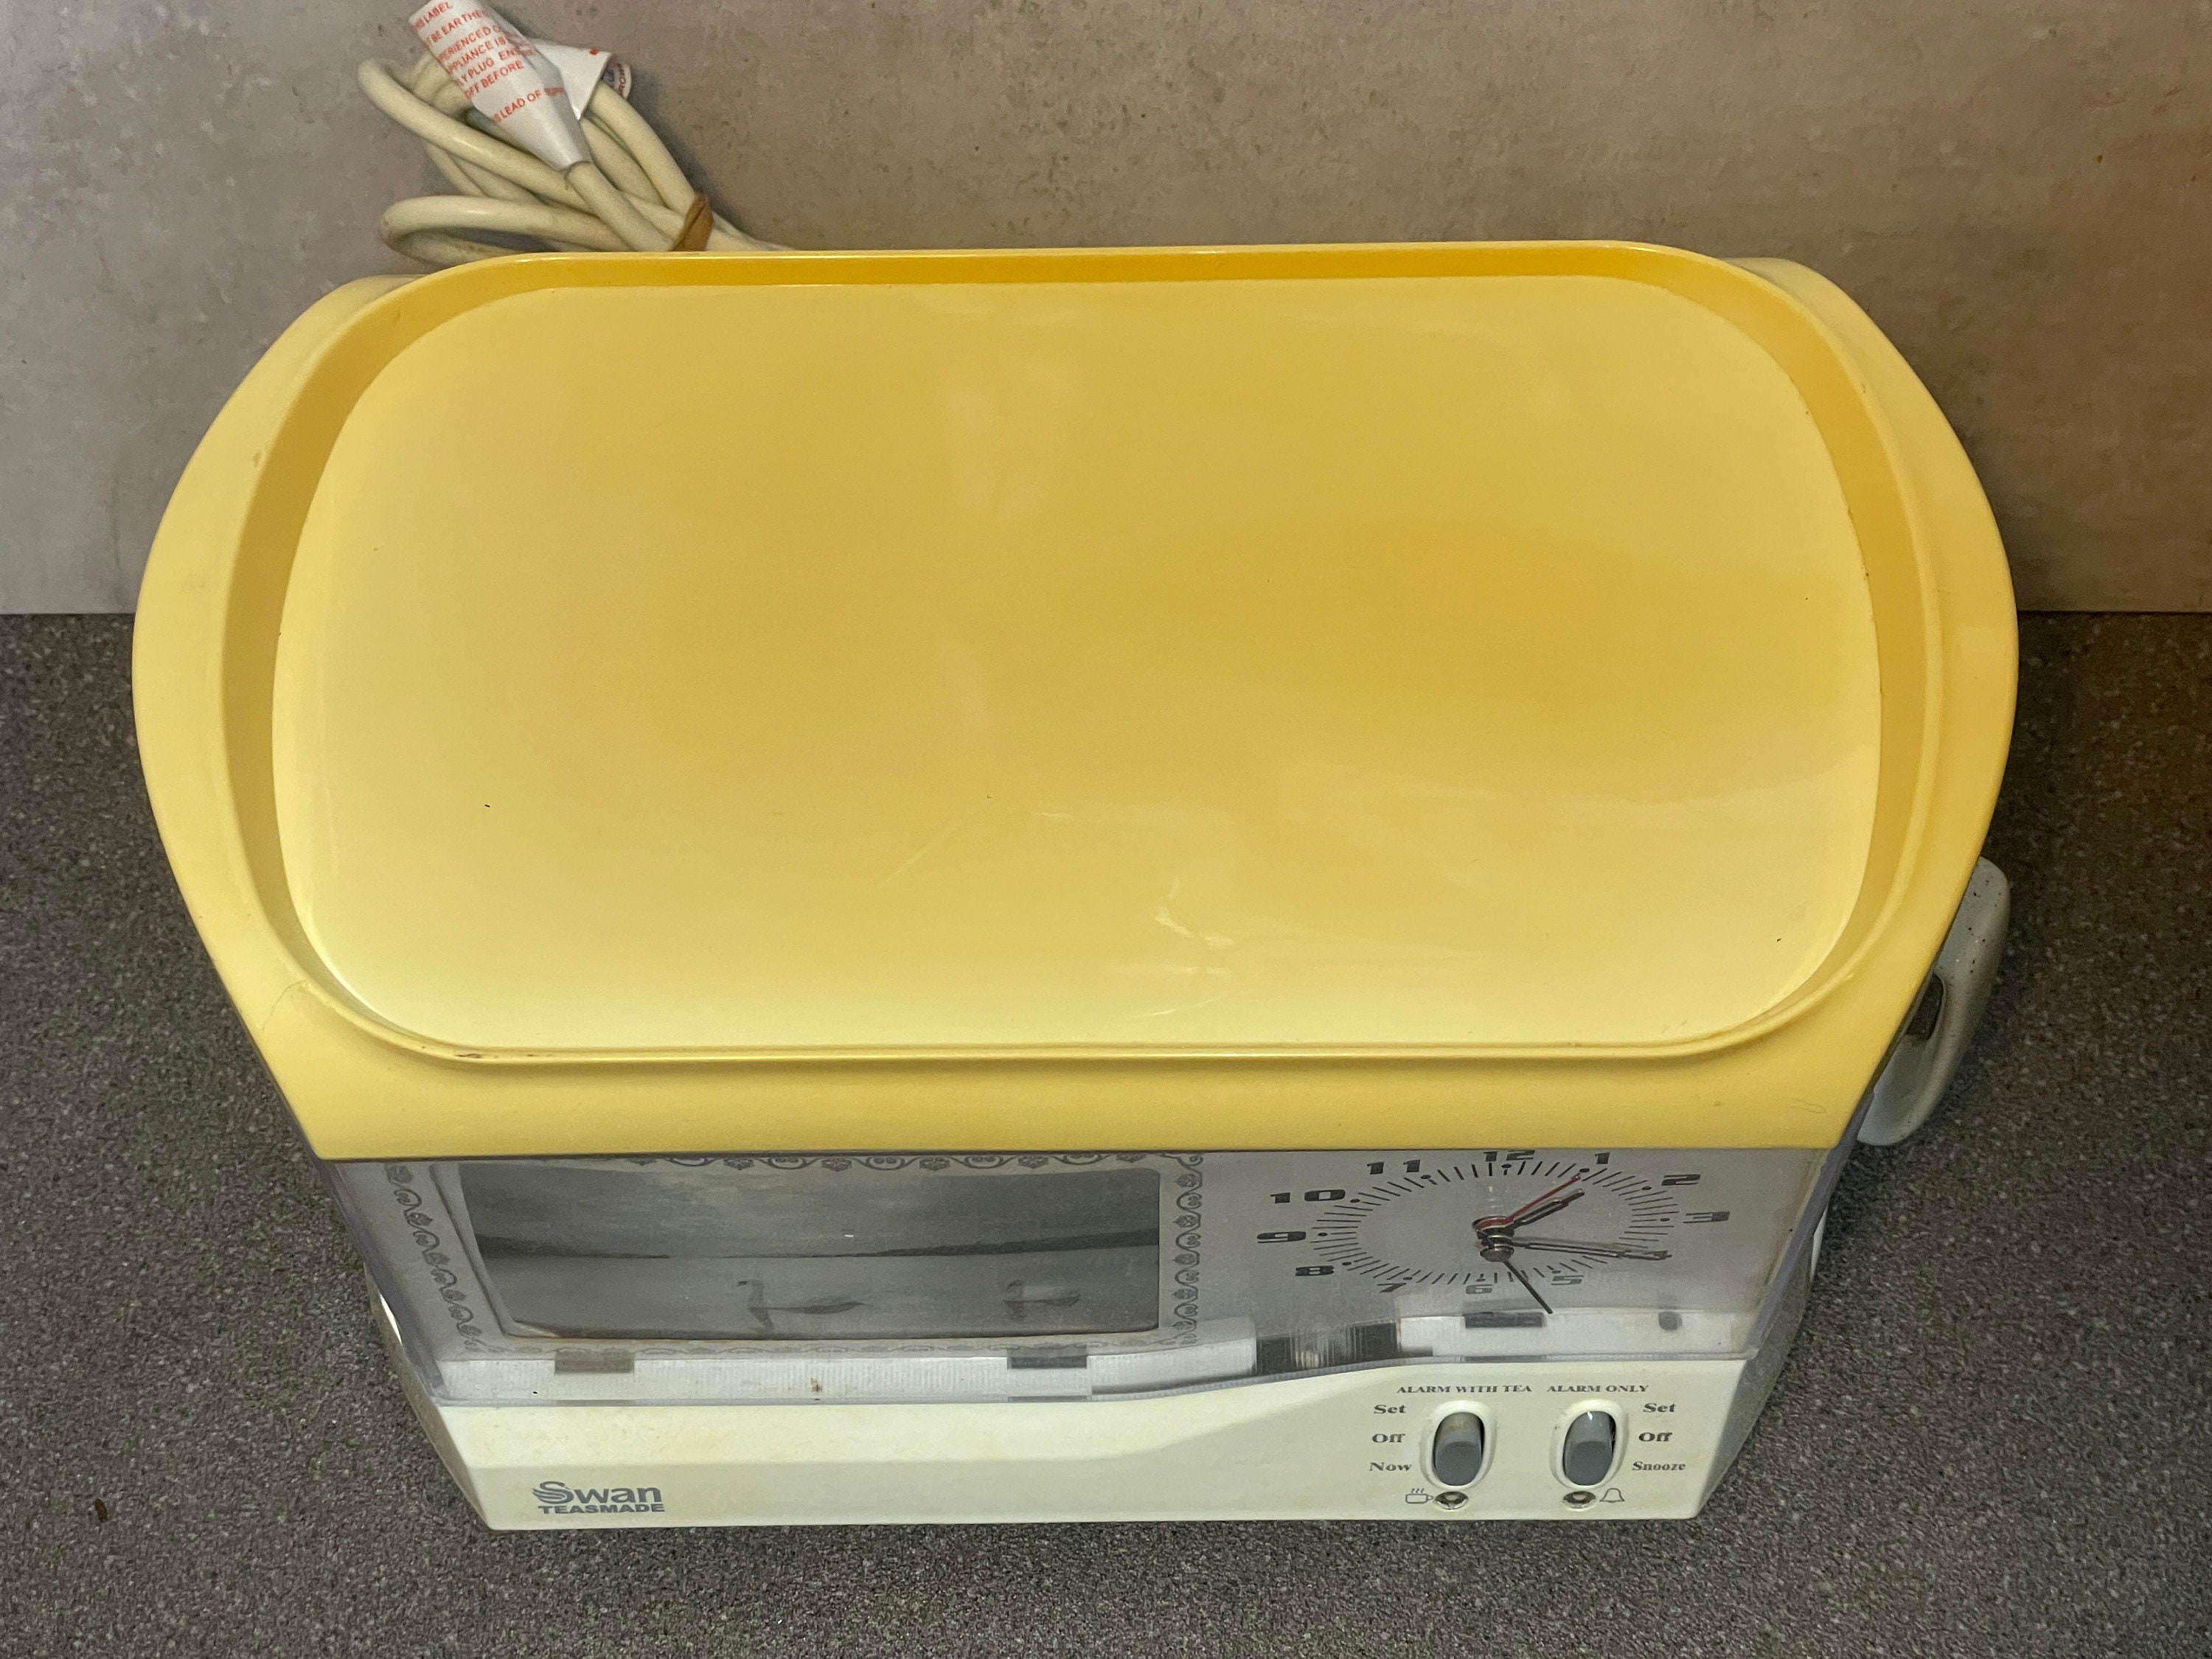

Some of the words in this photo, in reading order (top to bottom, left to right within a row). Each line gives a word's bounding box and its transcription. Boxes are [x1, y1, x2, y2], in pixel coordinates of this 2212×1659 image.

[481, 60, 524, 88] BEFORE
[501, 98, 525, 119] LEAD
[526, 89, 542, 102] OF
[1483, 1150, 1535, 1161] 12
[1595, 1152, 1610, 1164] 1
[1367, 1159, 1421, 1175] 11
[1661, 1174, 1701, 1186] 2
[1270, 1189, 1346, 1204] 10
[1683, 1211, 1730, 1224] 3
[1256, 1231, 1306, 1244] 9
[1295, 1265, 1335, 1276] 8
[1551, 1275, 1585, 1286] 5
[1377, 1282, 1407, 1293] 7
[1397, 1385, 1451, 1394] ALARM
[1455, 1385, 1498, 1394] WITH
[1503, 1385, 1532, 1393] TEA
[1547, 1385, 1601, 1394] ALARM
[1605, 1385, 1649, 1394] ONLY
[1374, 1404, 1407, 1415] Set
[1643, 1402, 1677, 1413] Set
[1371, 1433, 1405, 1444] Off
[1638, 1432, 1673, 1443] Off
[1369, 1461, 1413, 1472] Now
[1632, 1461, 1686, 1472] Snooze
[532, 1481, 662, 1504] Swan
[538, 1503, 665, 1514] TEASMADE
